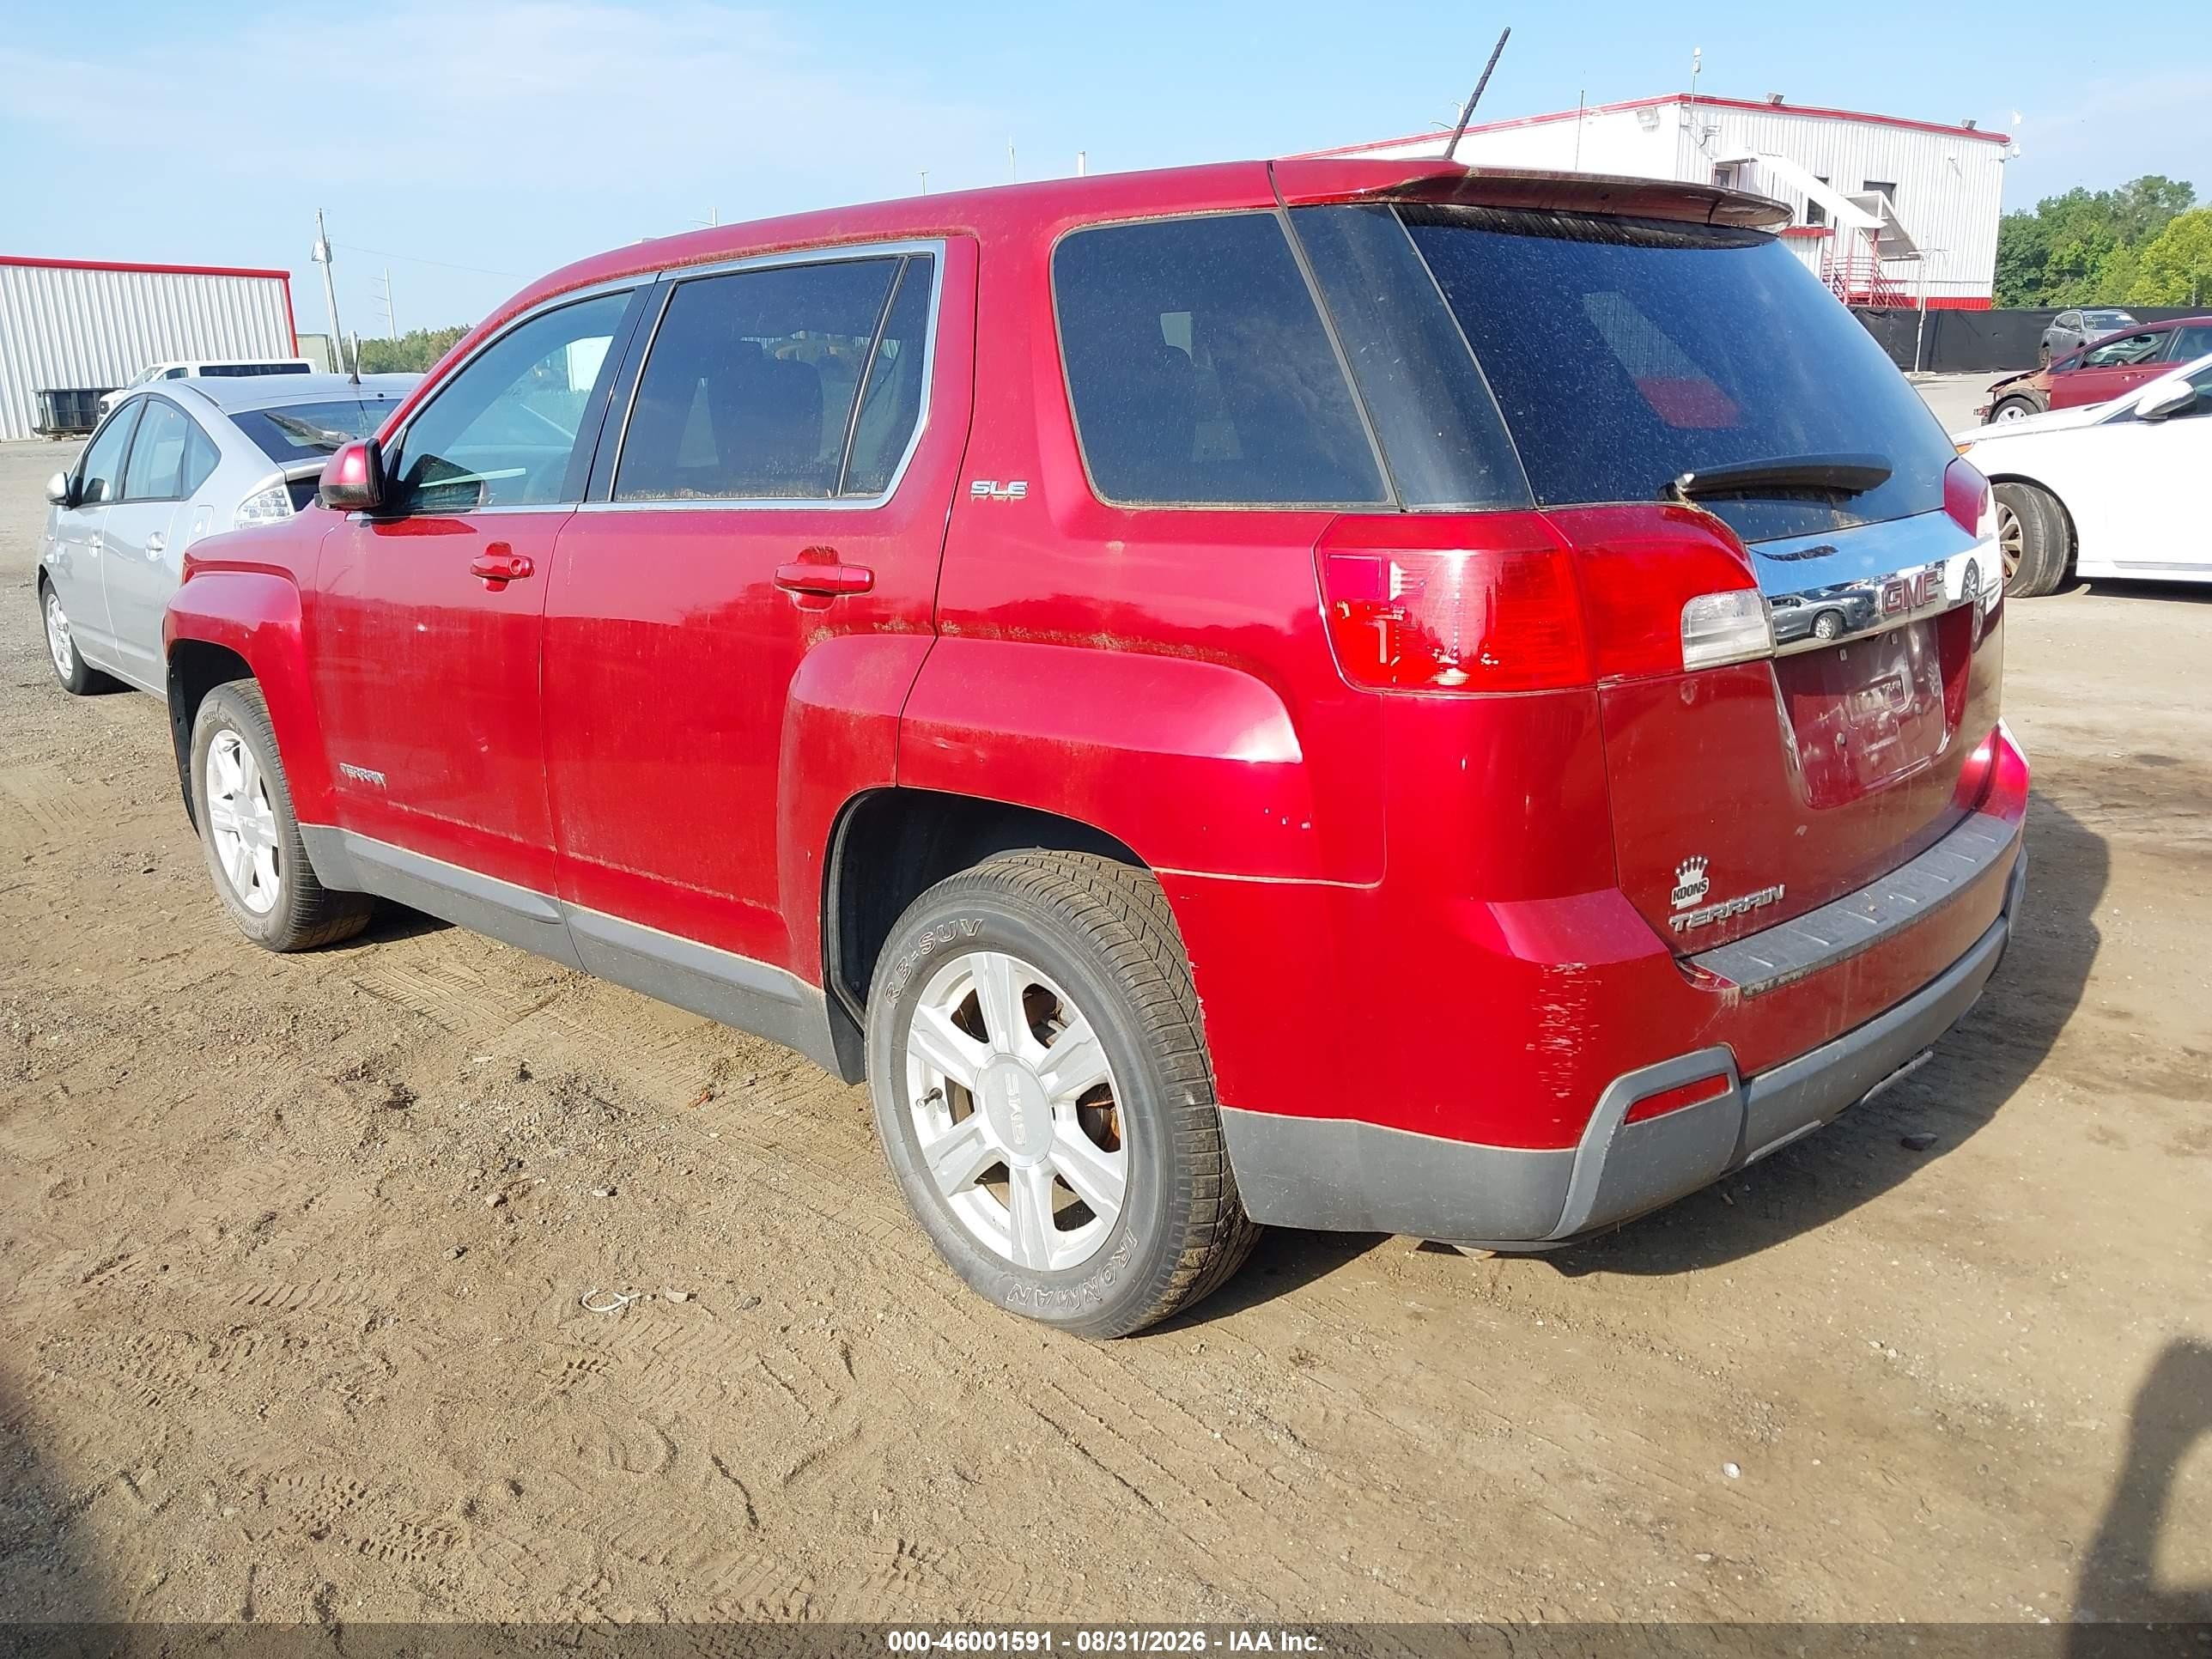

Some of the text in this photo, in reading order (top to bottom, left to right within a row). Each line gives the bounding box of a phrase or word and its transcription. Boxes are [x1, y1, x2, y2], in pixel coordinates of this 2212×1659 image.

[969, 480, 1029, 495] SLE
[1882, 568, 1940, 613] GMC
[1669, 884, 1786, 933] TERRAIN
[1673, 878, 1708, 902] KOONS
[1006, 1225, 1139, 1311] IRONMAN
